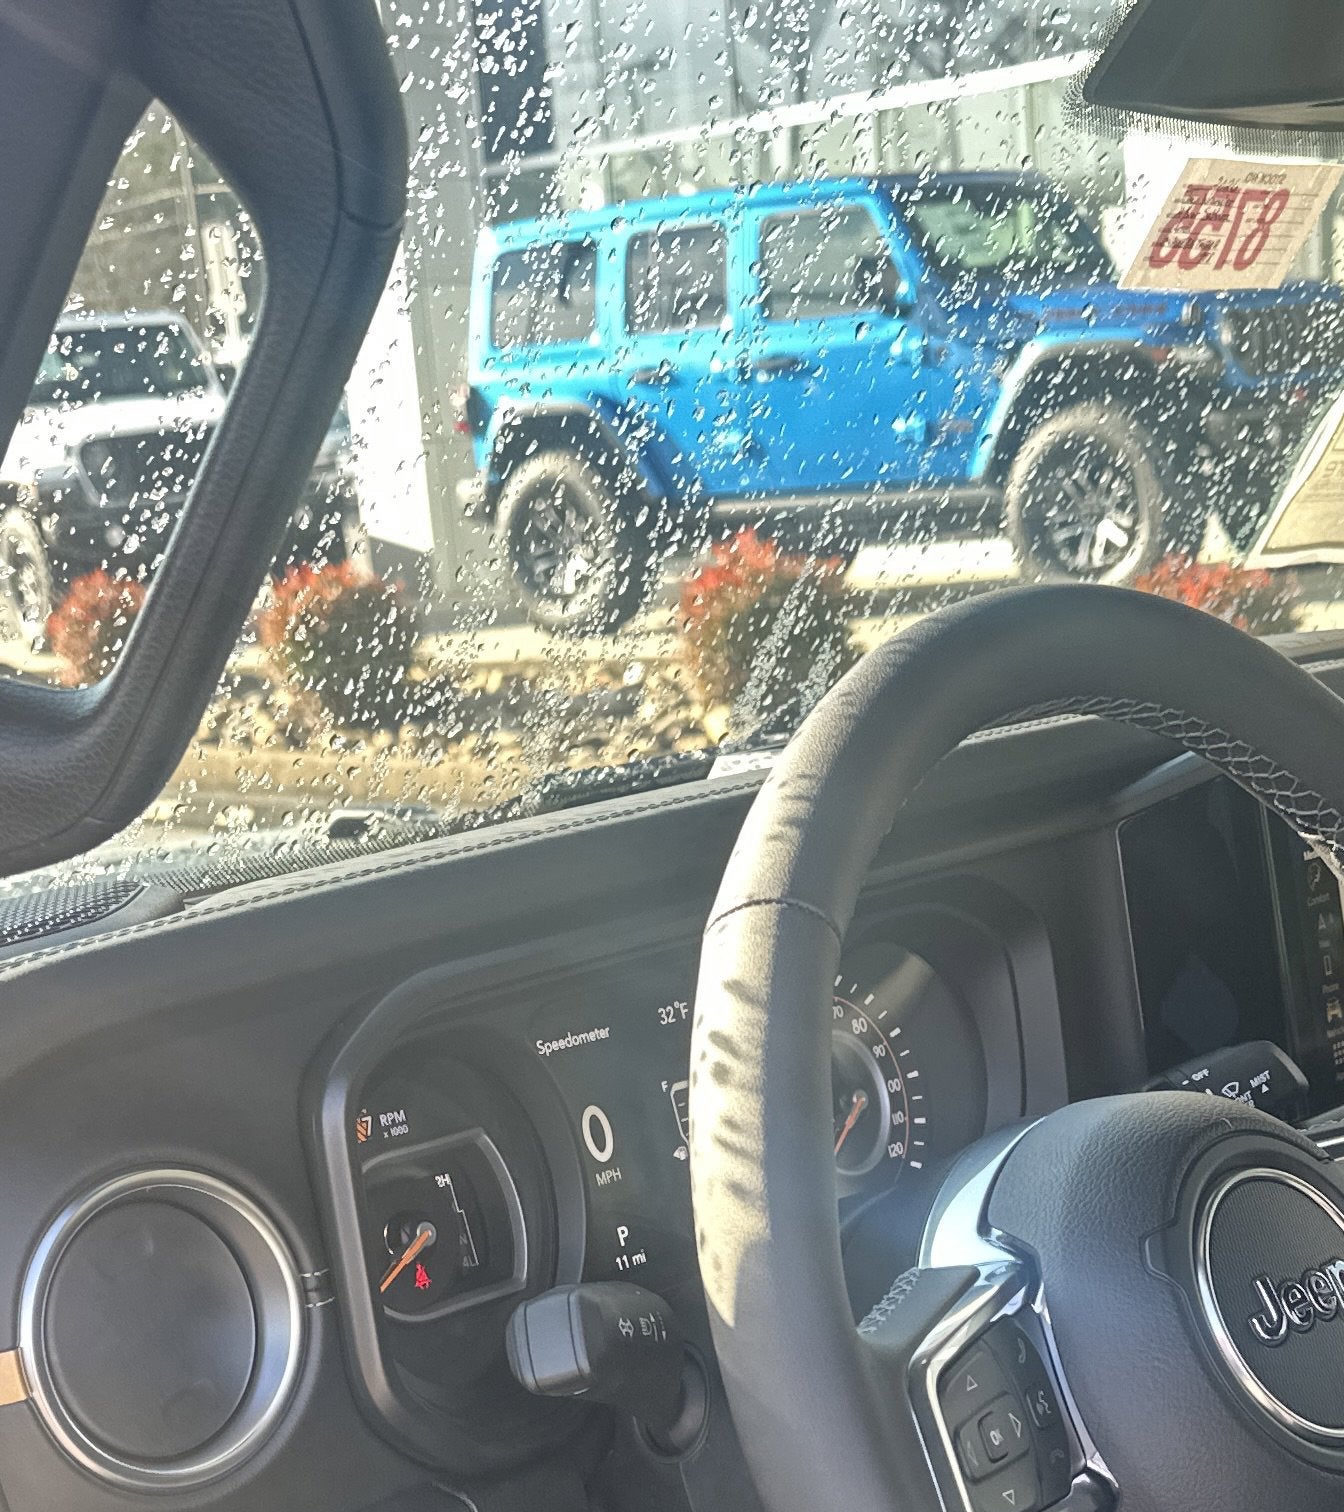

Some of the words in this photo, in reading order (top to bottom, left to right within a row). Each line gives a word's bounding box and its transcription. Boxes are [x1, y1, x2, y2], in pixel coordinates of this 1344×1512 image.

[851, 1017, 868, 1034] 80
[536, 1026, 610, 1056] Speedometer
[872, 1044, 886, 1058] 90
[661, 1080, 669, 1092] F
[379, 1109, 407, 1127] RPM
[582, 1104, 614, 1163] 0
[887, 1141, 904, 1158] 120
[595, 1167, 622, 1187] MPH
[616, 1225, 630, 1247] P
[615, 1254, 630, 1271] 11
[632, 1249, 647, 1266] mi
